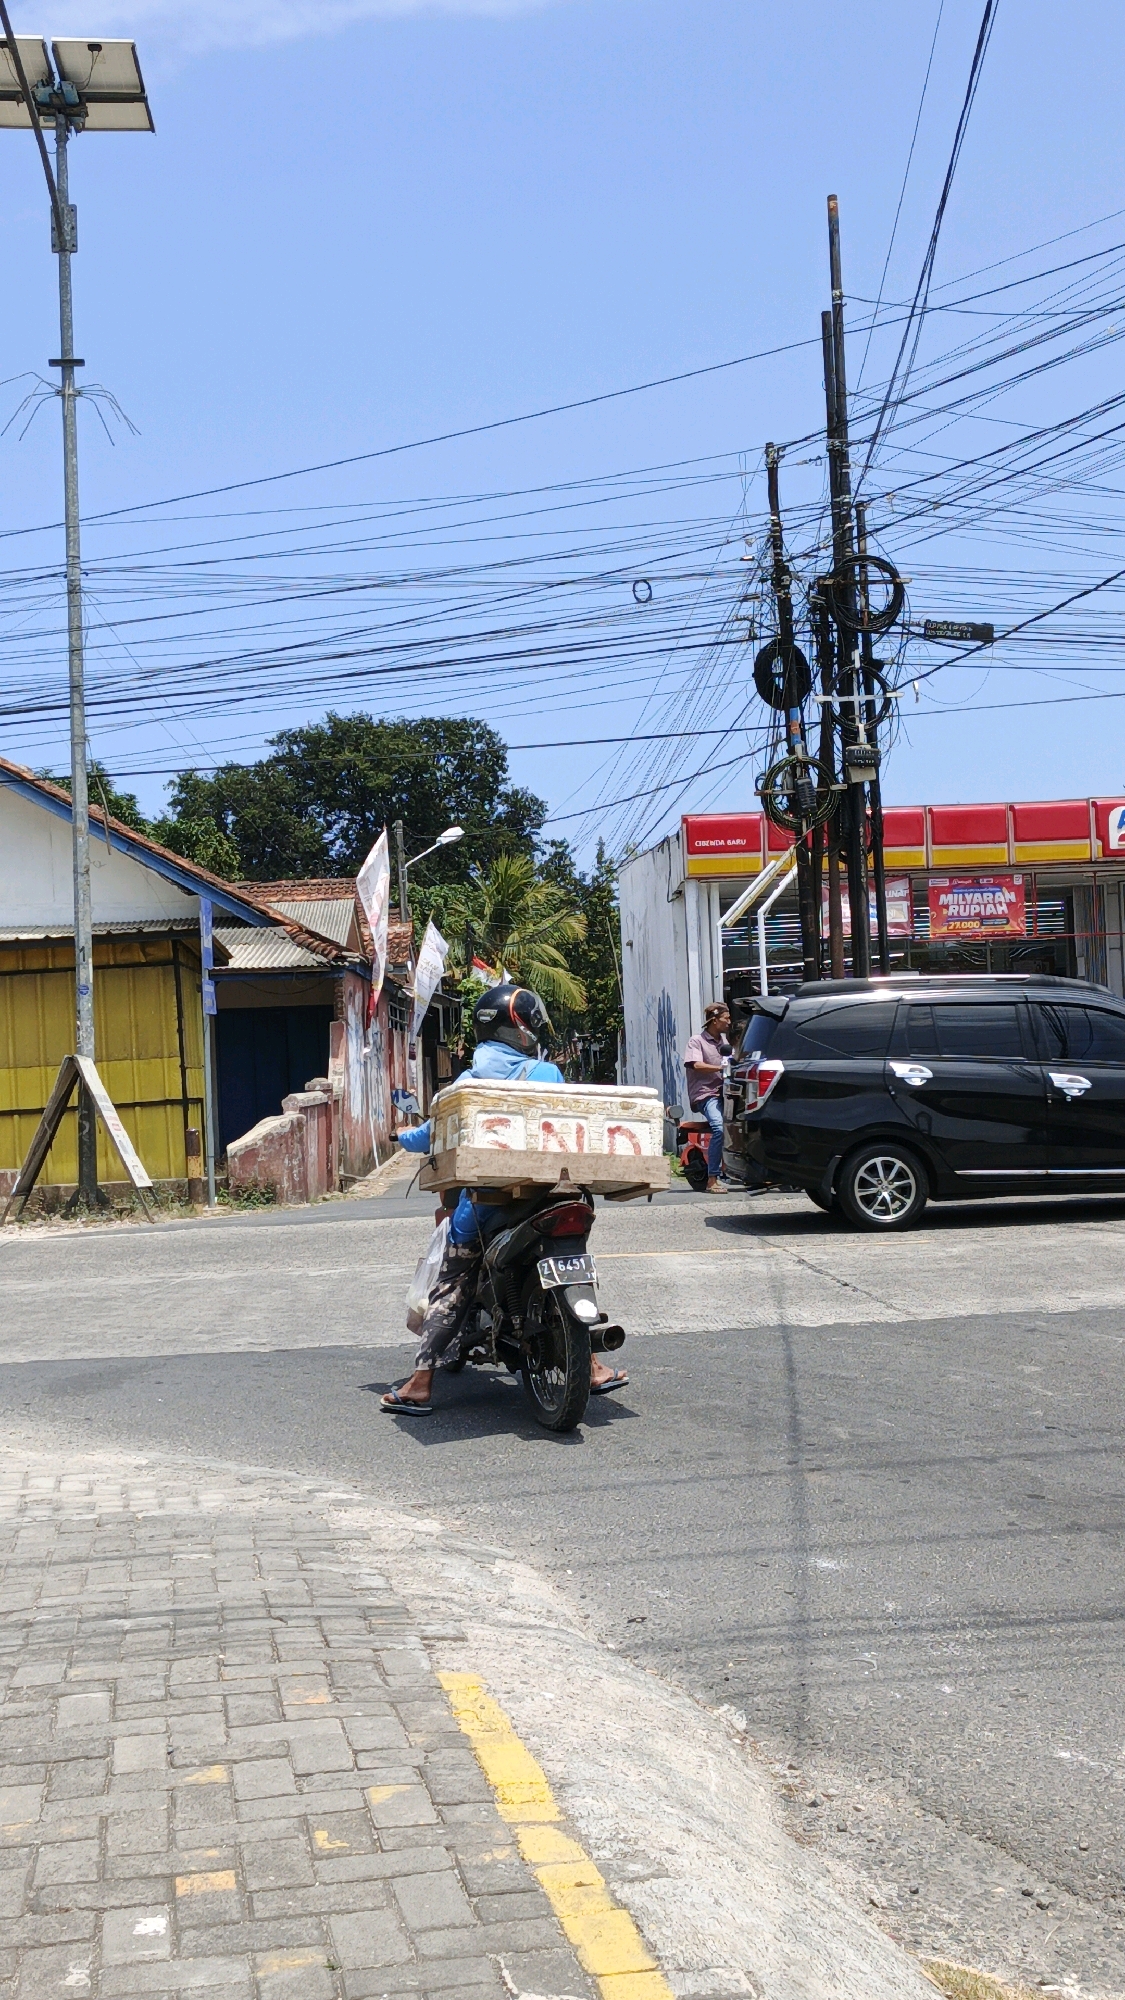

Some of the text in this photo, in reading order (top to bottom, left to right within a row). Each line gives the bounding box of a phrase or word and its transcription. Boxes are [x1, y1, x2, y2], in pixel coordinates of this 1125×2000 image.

[939, 891, 1016, 905] MILYARAN
[948, 902, 1008, 916] RUPIAH
[542, 1257, 586, 1275] Z 6451
